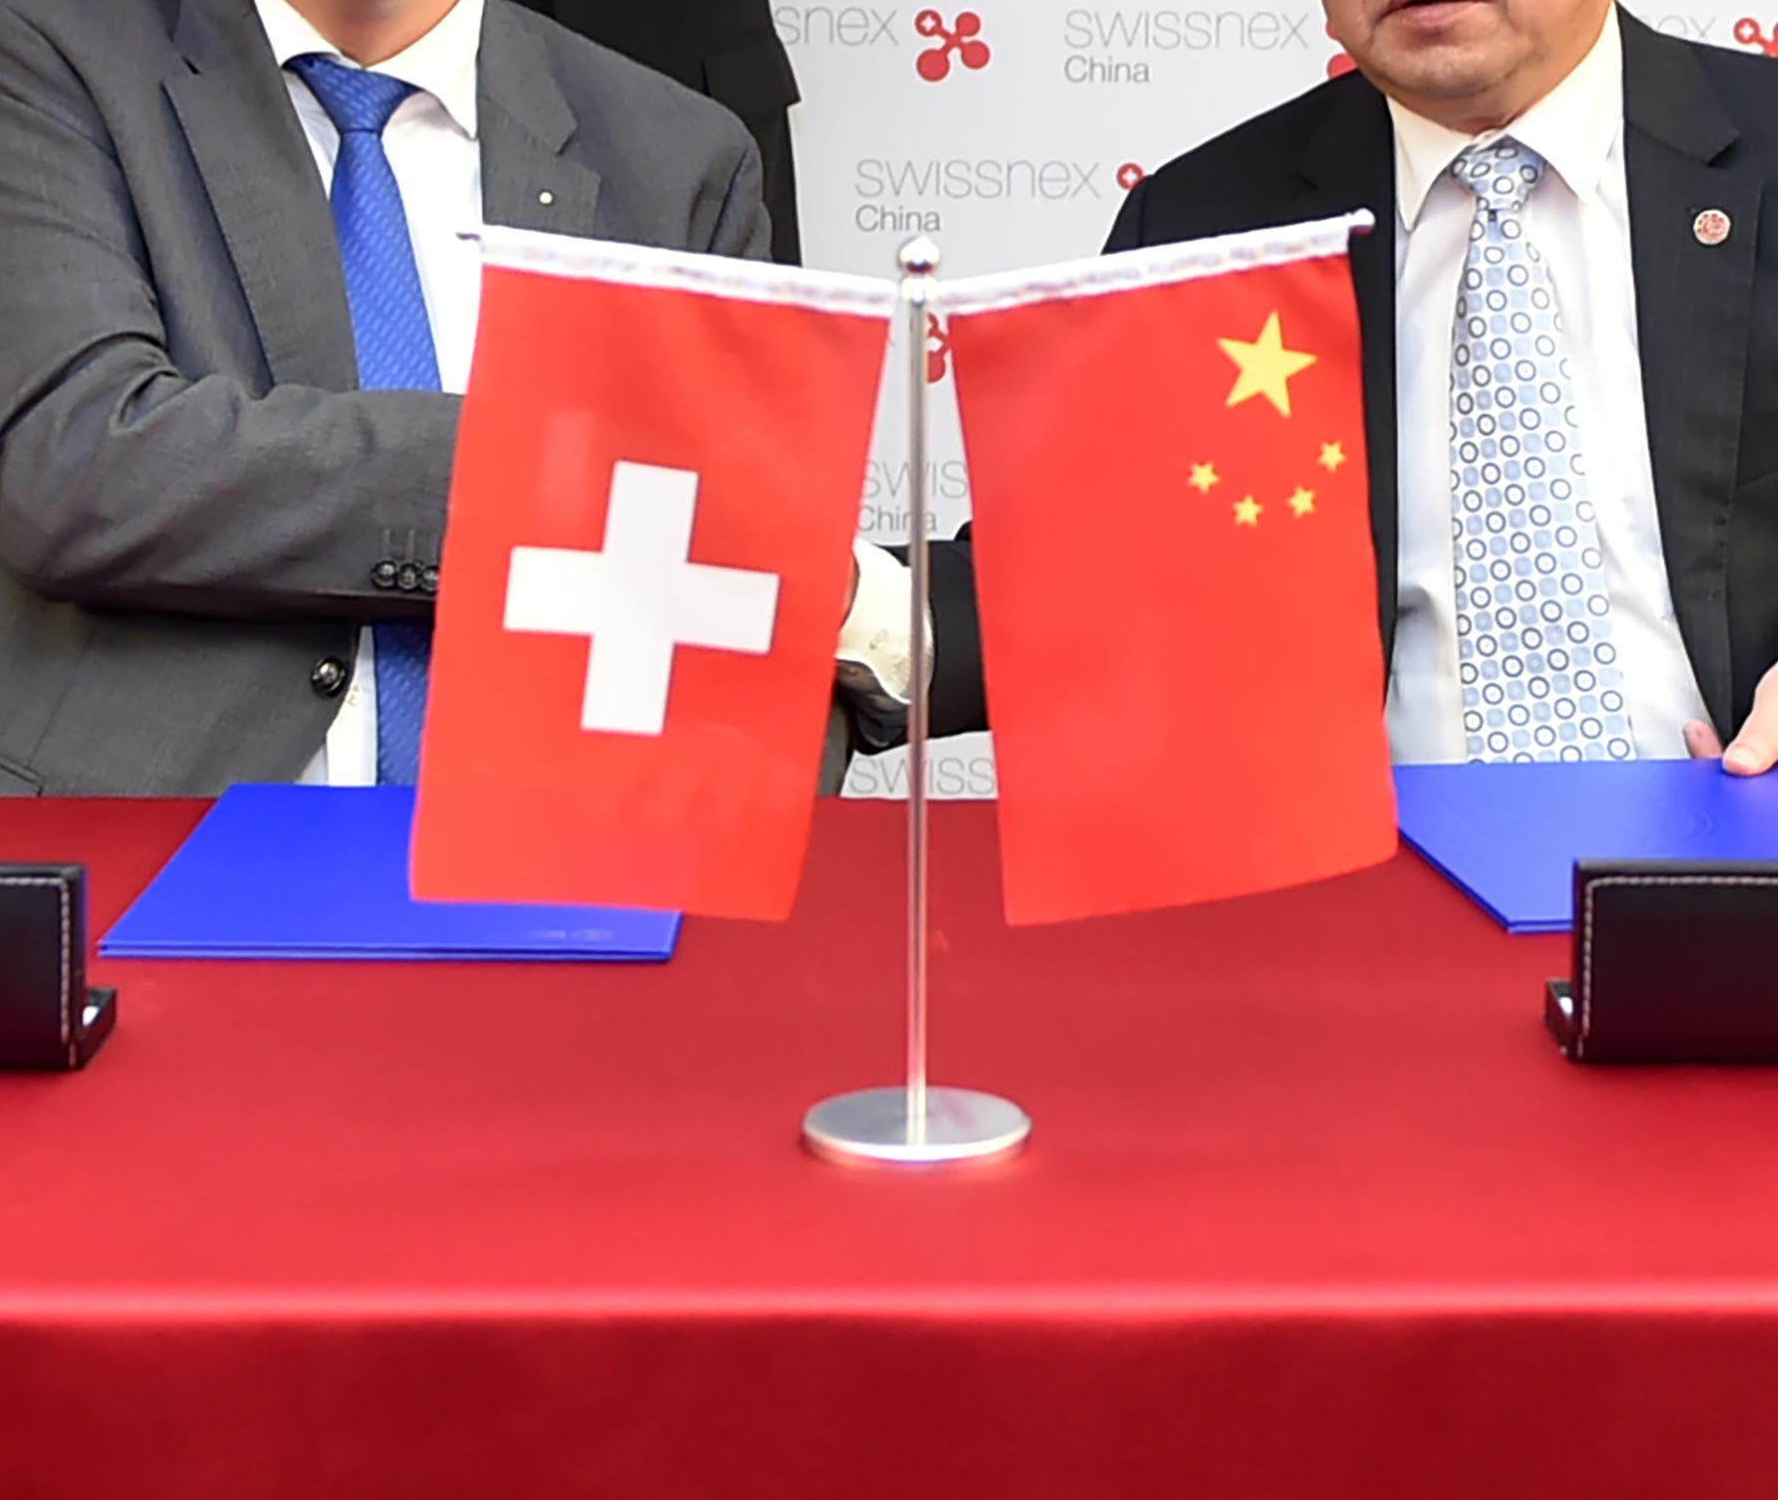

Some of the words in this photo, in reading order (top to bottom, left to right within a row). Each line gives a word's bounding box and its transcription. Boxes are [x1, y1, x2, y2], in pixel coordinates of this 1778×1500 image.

[1063, 8, 1307, 49] swissnex
[1064, 54, 1150, 84] China
[857, 158, 1100, 198] swissnex
[855, 204, 941, 235] China
